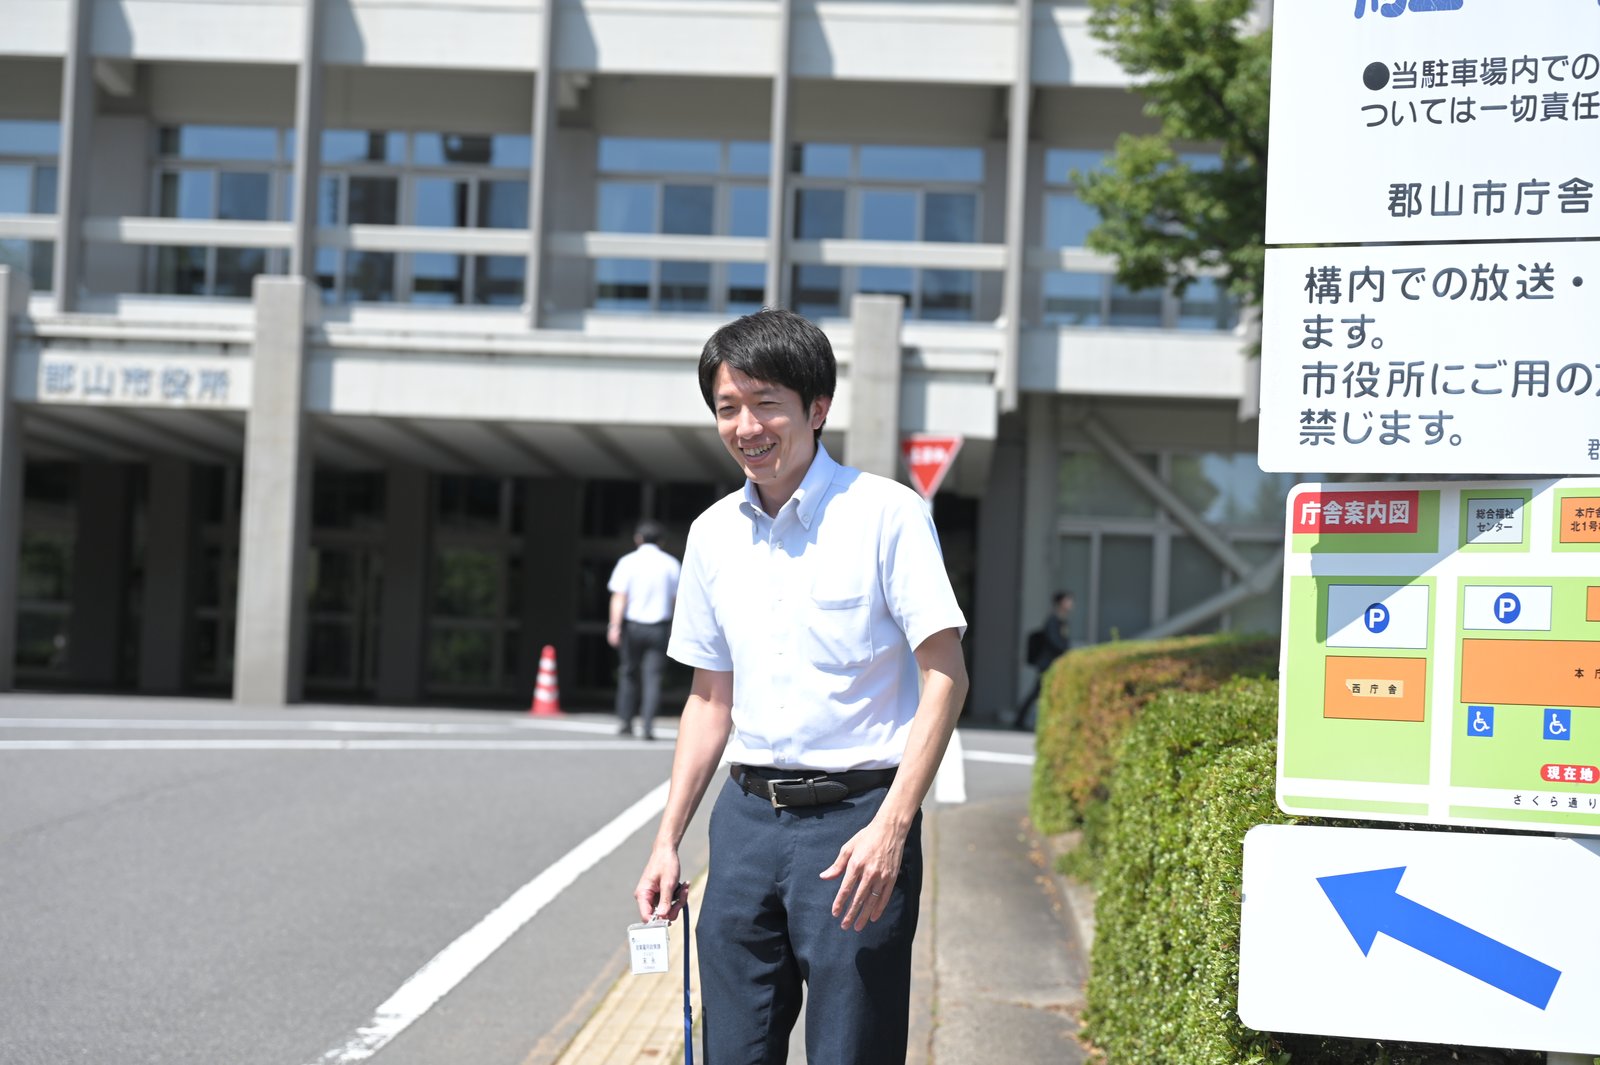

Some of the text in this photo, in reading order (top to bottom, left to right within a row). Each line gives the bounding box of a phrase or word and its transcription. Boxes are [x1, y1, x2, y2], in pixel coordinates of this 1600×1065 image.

[1361, 91, 1600, 127] ついては一切責任
[1387, 177, 1593, 218] 郡山市庁舎
[1304, 262, 1584, 305] 構内での放送・
[1302, 314, 1383, 349] ます。
[1302, 359, 1600, 398] 市役所にご用の
[1299, 408, 1462, 445] 禁じます。
[1300, 500, 1410, 525] 庁舎案内図
[1476, 508, 1515, 519] 総合福祉
[1477, 522, 1513, 532] センター
[1571, 520, 1600, 532] 北1号
[1369, 608, 1385, 628] P
[1499, 598, 1516, 618] P
[1352, 683, 1397, 695] 西庁舎
[1547, 766, 1594, 782] 現在地
[1513, 794, 1597, 809] さくら通り
